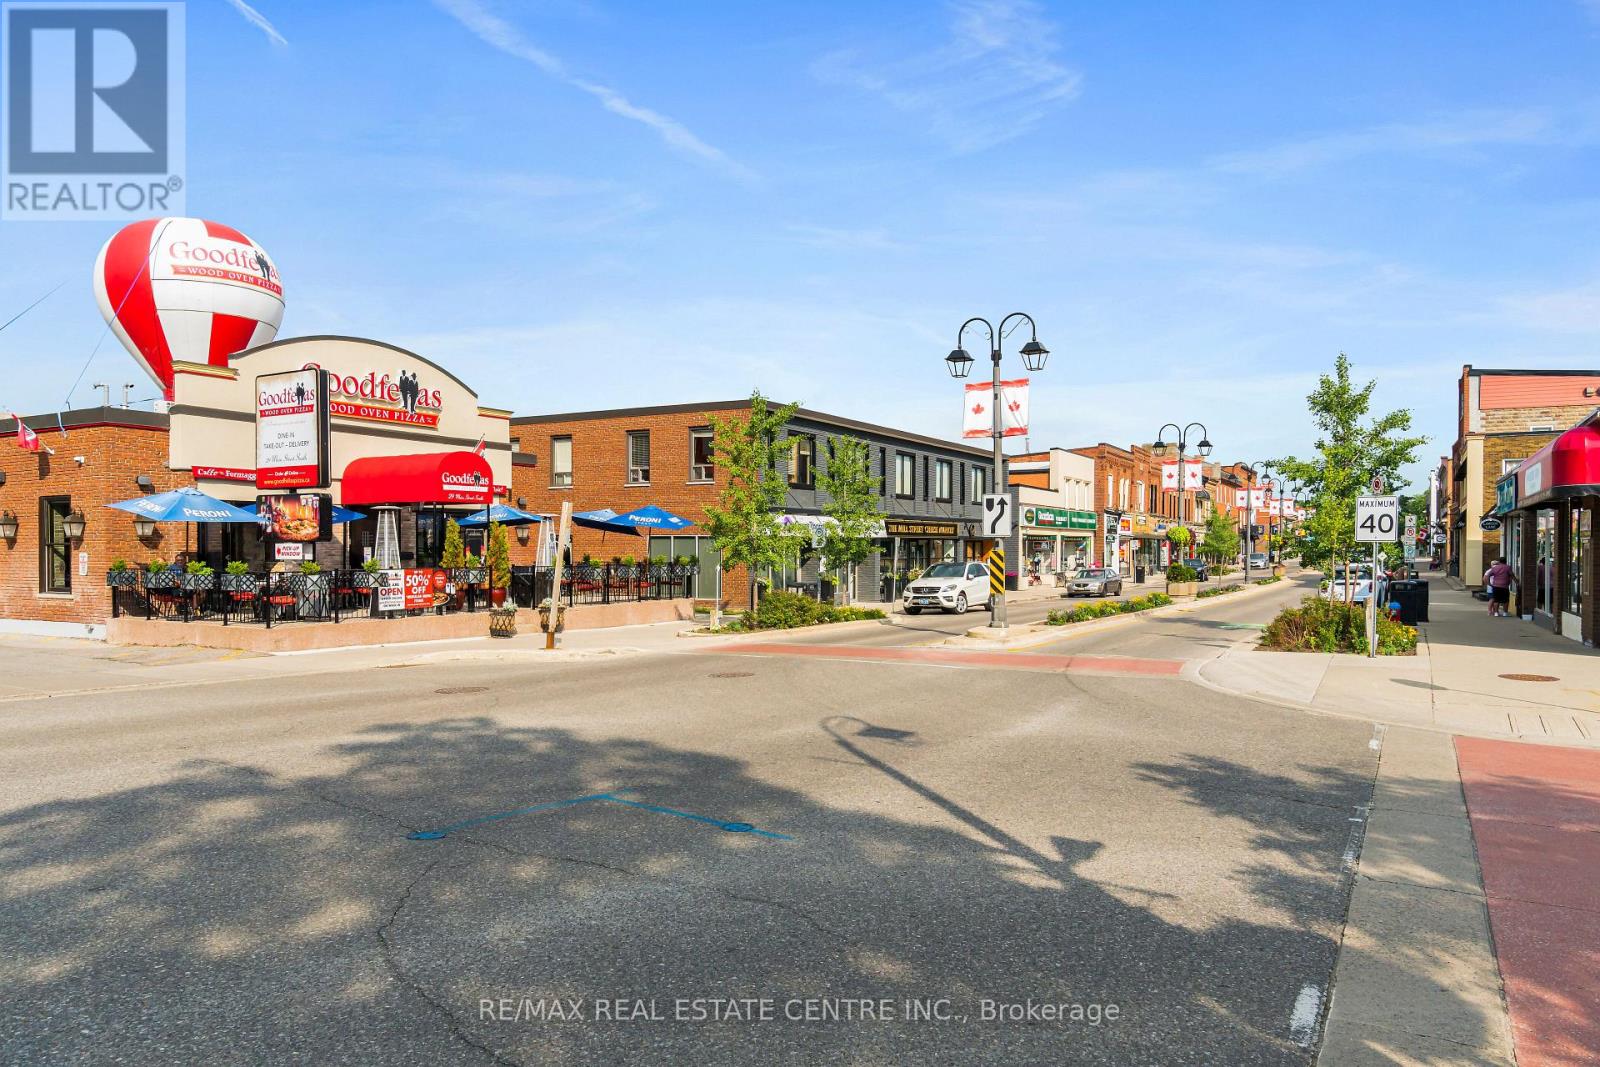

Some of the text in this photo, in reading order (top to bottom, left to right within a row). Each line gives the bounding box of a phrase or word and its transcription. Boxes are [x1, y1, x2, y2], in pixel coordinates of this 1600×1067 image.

[169, 241, 281, 280] Goodfeas
[188, 266, 278, 293] WOOD OVEN PIZZA
[303, 363, 442, 409] oodfeas
[258, 386, 315, 406] Goodfeas
[294, 406, 309, 414] PIZZA
[330, 403, 428, 424] OOD OVEN PIZZA
[288, 440, 310, 448] DELIVERY
[442, 472, 489, 485] Goodfeas
[1359, 500, 1395, 508] MAXIMUM
[183, 507, 232, 518] PERONI
[473, 513, 508, 521] PEONI
[628, 514, 662, 524] PERONI
[1359, 513, 1394, 534] 40
[380, 587, 403, 596] OPEN
[411, 586, 427, 594] OFF
